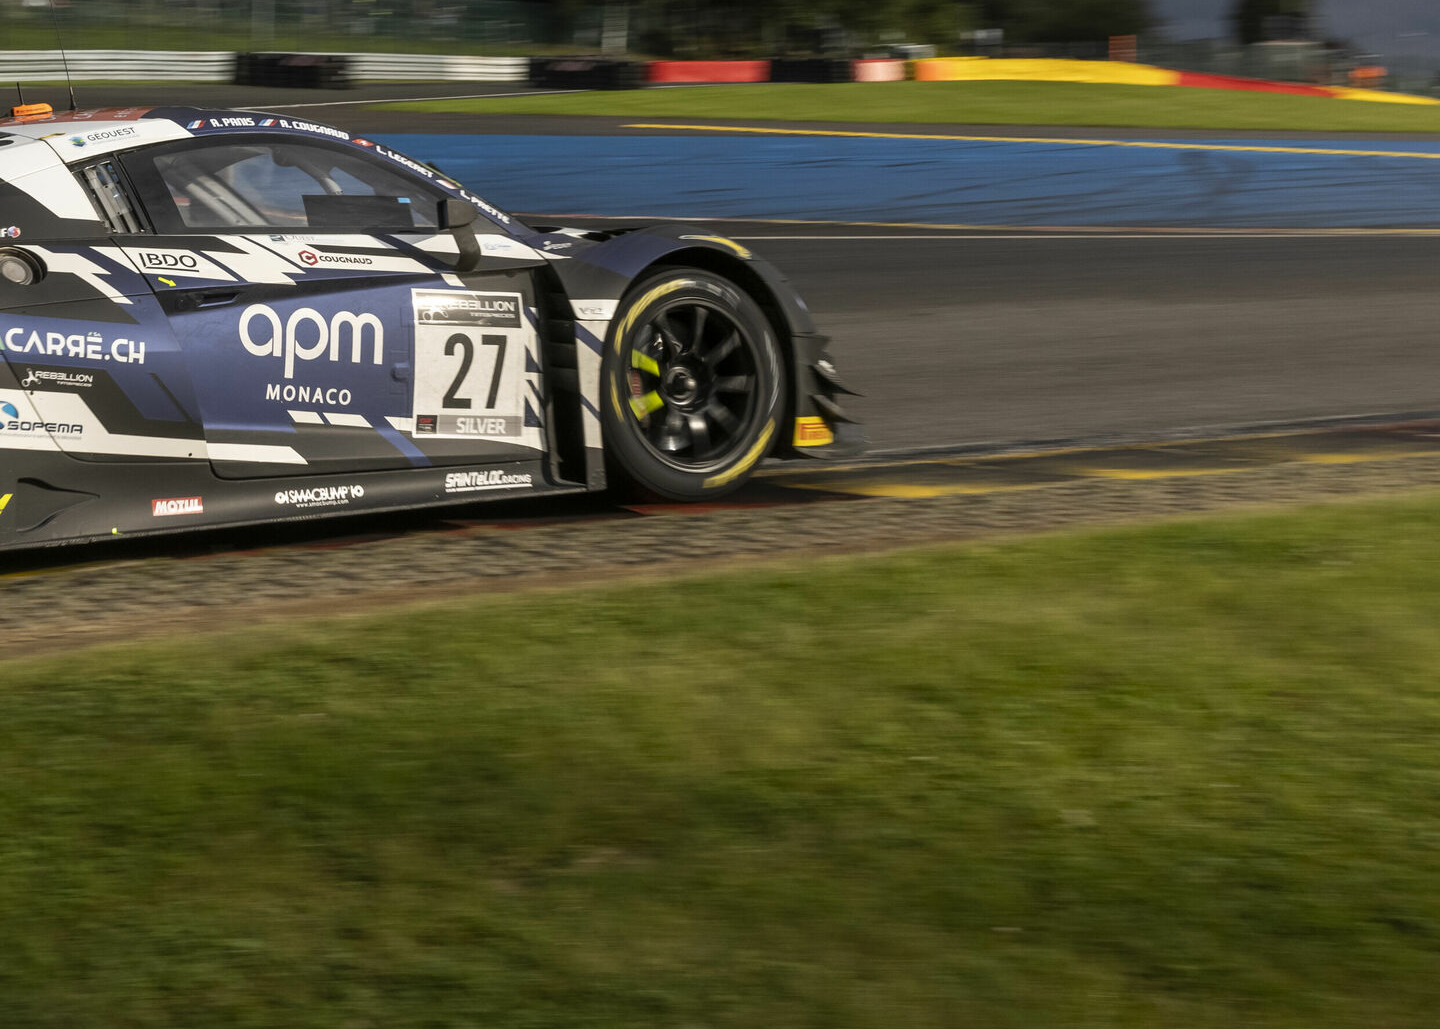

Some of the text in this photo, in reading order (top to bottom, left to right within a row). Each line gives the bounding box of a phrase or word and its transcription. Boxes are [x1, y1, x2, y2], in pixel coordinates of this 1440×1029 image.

[222, 117, 255, 127] PANIS
[291, 120, 350, 140] COUGNAUD
[319, 255, 373, 265] COUGNAUD
[239, 303, 384, 379] apm
[441, 333, 508, 410] 27
[265, 383, 352, 406] MONACO
[7, 420, 83, 434] SOPEMA
[456, 417, 506, 434] SILVER
[155, 499, 204, 515] MOTUL
